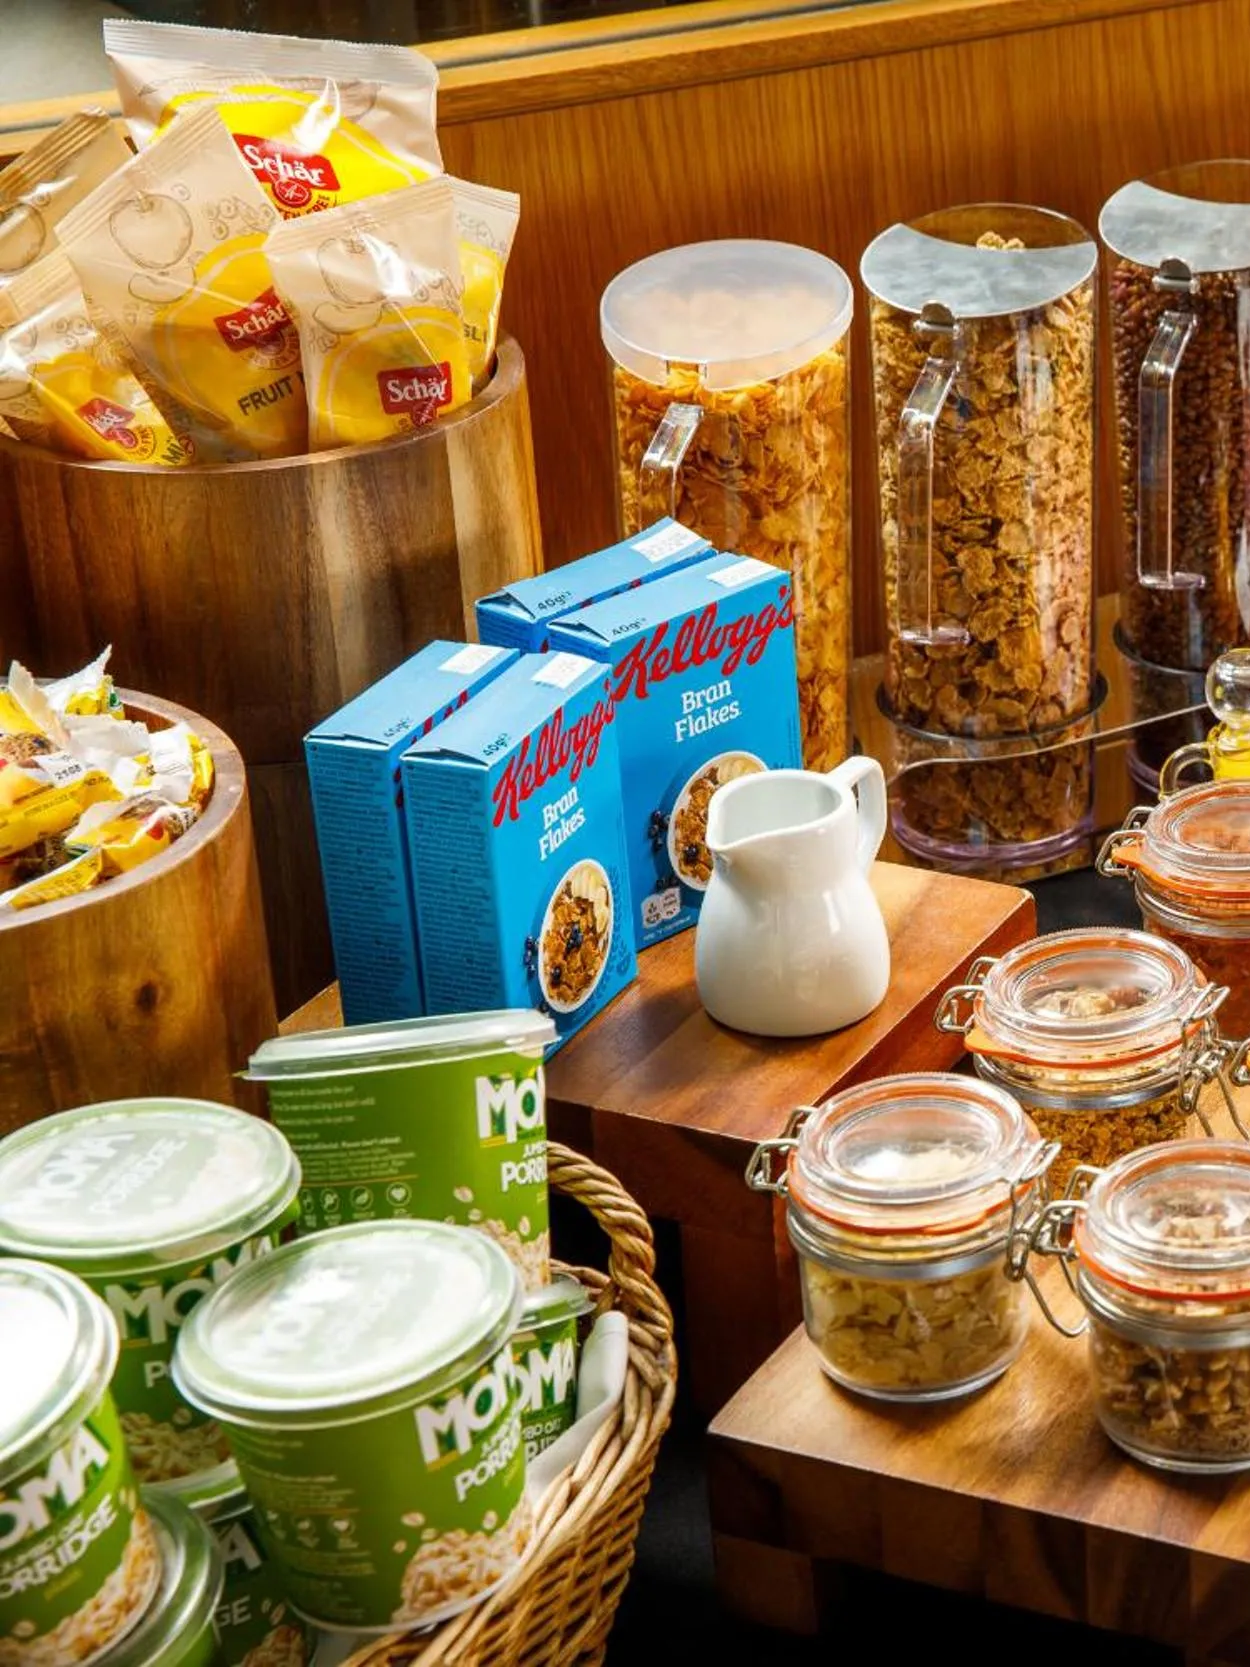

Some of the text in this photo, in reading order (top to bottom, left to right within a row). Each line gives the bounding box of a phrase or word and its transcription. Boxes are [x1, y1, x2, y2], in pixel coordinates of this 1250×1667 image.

[243, 144, 327, 187] Schär
[237, 376, 293, 417] FRUIT
[386, 377, 448, 403] Schär
[613, 584, 793, 701] Kellogg's
[681, 679, 732, 715] Bran
[674, 700, 741, 743] Flakes
[492, 678, 616, 828] Kellogg's
[542, 786, 580, 831] Bran
[538, 808, 587, 862] Flakes
[0, 1422, 110, 1550] OMA
[0, 1493, 118, 1600] ORRIDGE
